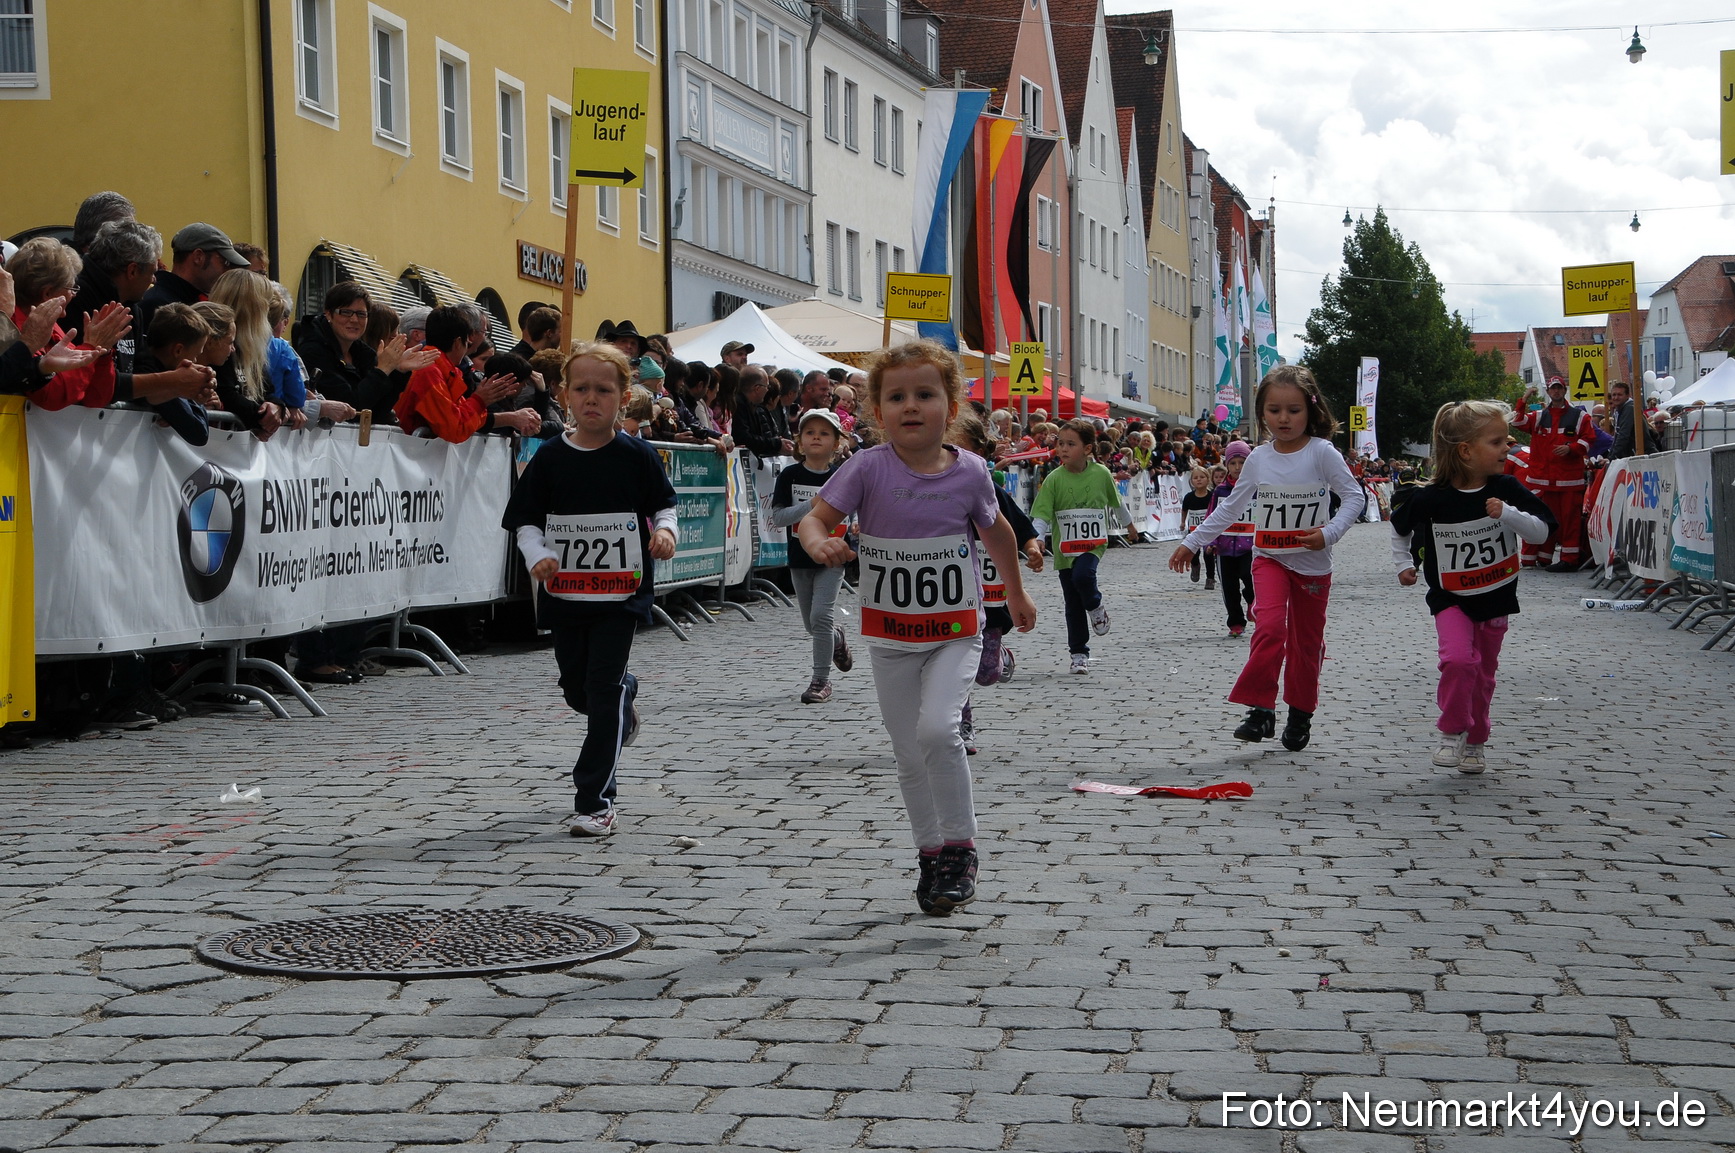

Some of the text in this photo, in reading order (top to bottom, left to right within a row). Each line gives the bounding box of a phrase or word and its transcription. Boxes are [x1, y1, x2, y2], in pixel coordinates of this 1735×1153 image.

[575, 99, 646, 122] Jugend-
[593, 123, 626, 141] lauf
[890, 285, 946, 299] Schnupper-
[1566, 277, 1629, 291] Schnupper-
[908, 300, 926, 309] lauf
[1588, 291, 1608, 302] lauf
[1014, 344, 1040, 354] Block
[1572, 348, 1603, 358] Block
[1016, 358, 1035, 383] A
[1577, 362, 1600, 389] A
[1354, 414, 1363, 425] B
[181, 463, 244, 509] BMW
[793, 489, 813, 497] PARTL
[260, 477, 444, 536] BMW EfficientDynamics
[1263, 502, 1320, 529] 7177
[547, 523, 623, 533] PARTL Neumarkt
[1064, 522, 1100, 540] 7190
[1461, 522, 1502, 537] Neumarkt
[1262, 534, 1300, 548] Magda
[555, 537, 627, 570] 7221
[860, 545, 955, 562] PARTL Neumarkt
[1444, 531, 1508, 570] 7251
[258, 552, 308, 592] Weniger
[368, 540, 394, 573] Mehr
[551, 576, 636, 593] Anna-Sophia
[869, 564, 963, 608] 7060
[1460, 567, 1506, 588] Carlotta
[883, 616, 951, 638] Mareike
